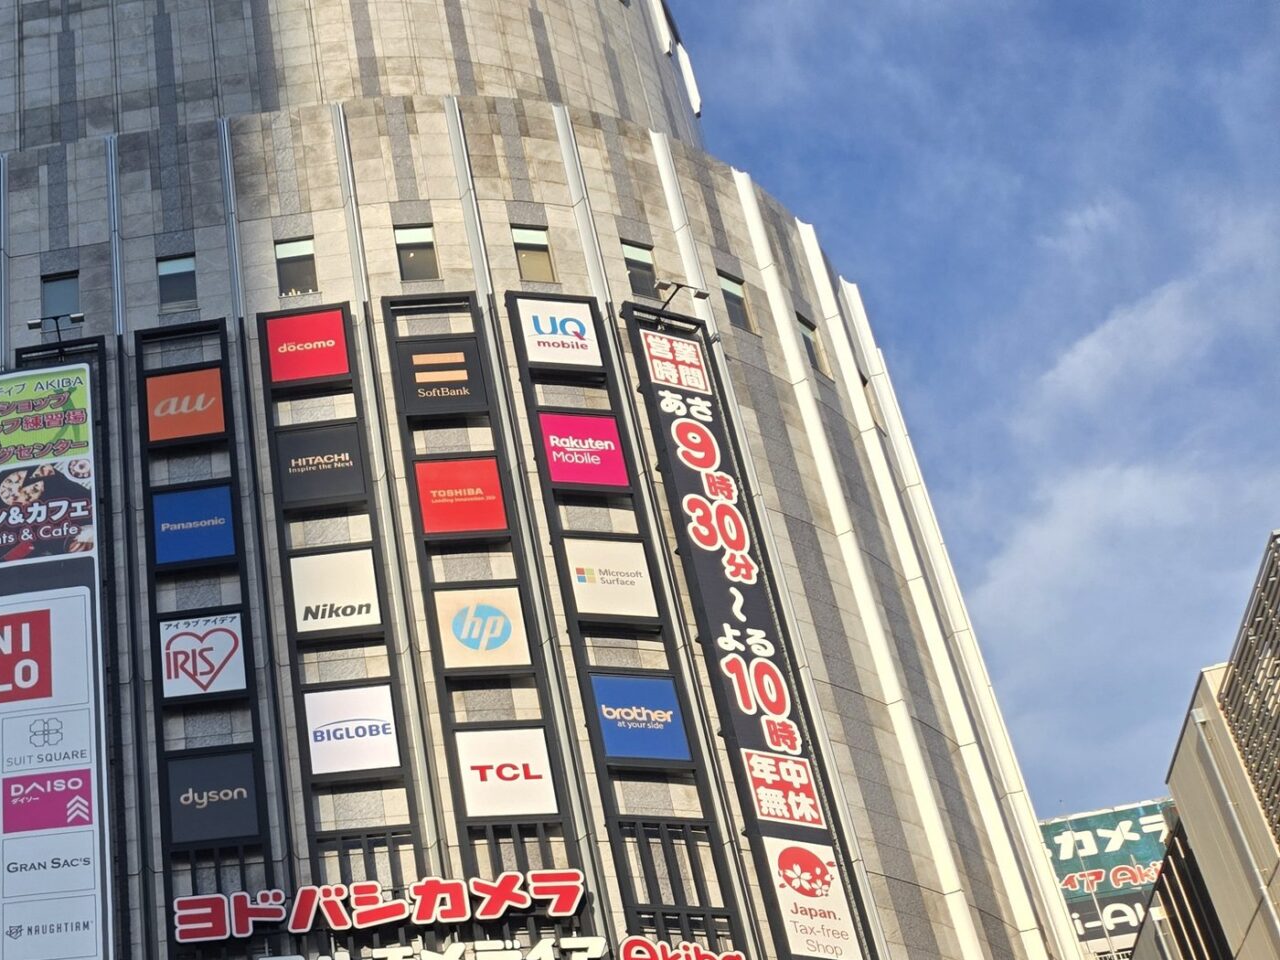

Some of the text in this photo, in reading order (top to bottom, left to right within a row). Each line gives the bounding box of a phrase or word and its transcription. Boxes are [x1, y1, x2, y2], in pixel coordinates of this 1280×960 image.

[536, 340, 589, 351] mobile
[34, 376, 84, 392] AKIBA
[417, 388, 470, 398] SoftBank
[153, 393, 216, 417] au
[549, 435, 615, 451] Rakuten
[291, 453, 350, 467] HITACHI
[552, 450, 601, 465] Mobile
[288, 466, 317, 474] Inspire
[430, 487, 484, 498] TOSHIBA
[21, 529, 33, 540] &
[39, 525, 79, 538] Cafe
[161, 516, 226, 532] Panasonic
[598, 568, 643, 579] Microsoft
[600, 577, 636, 586] Surface
[303, 602, 371, 621] Nikon
[460, 604, 505, 650] hp
[166, 647, 215, 680] IRIS
[602, 704, 673, 722] brother
[313, 723, 393, 743] BIGLOBE
[617, 720, 664, 731] at your side
[6, 749, 87, 767] SUIT SQUARE
[471, 763, 543, 782] TCL
[10, 777, 83, 797] DAISO
[180, 786, 247, 808] dyson
[7, 860, 47, 874] GRAN
[174, 868, 584, 943] ヨドバシカメラ
[790, 903, 841, 921] Japan.
[790, 920, 849, 941] Tax-free
[805, 938, 843, 958] Shop
